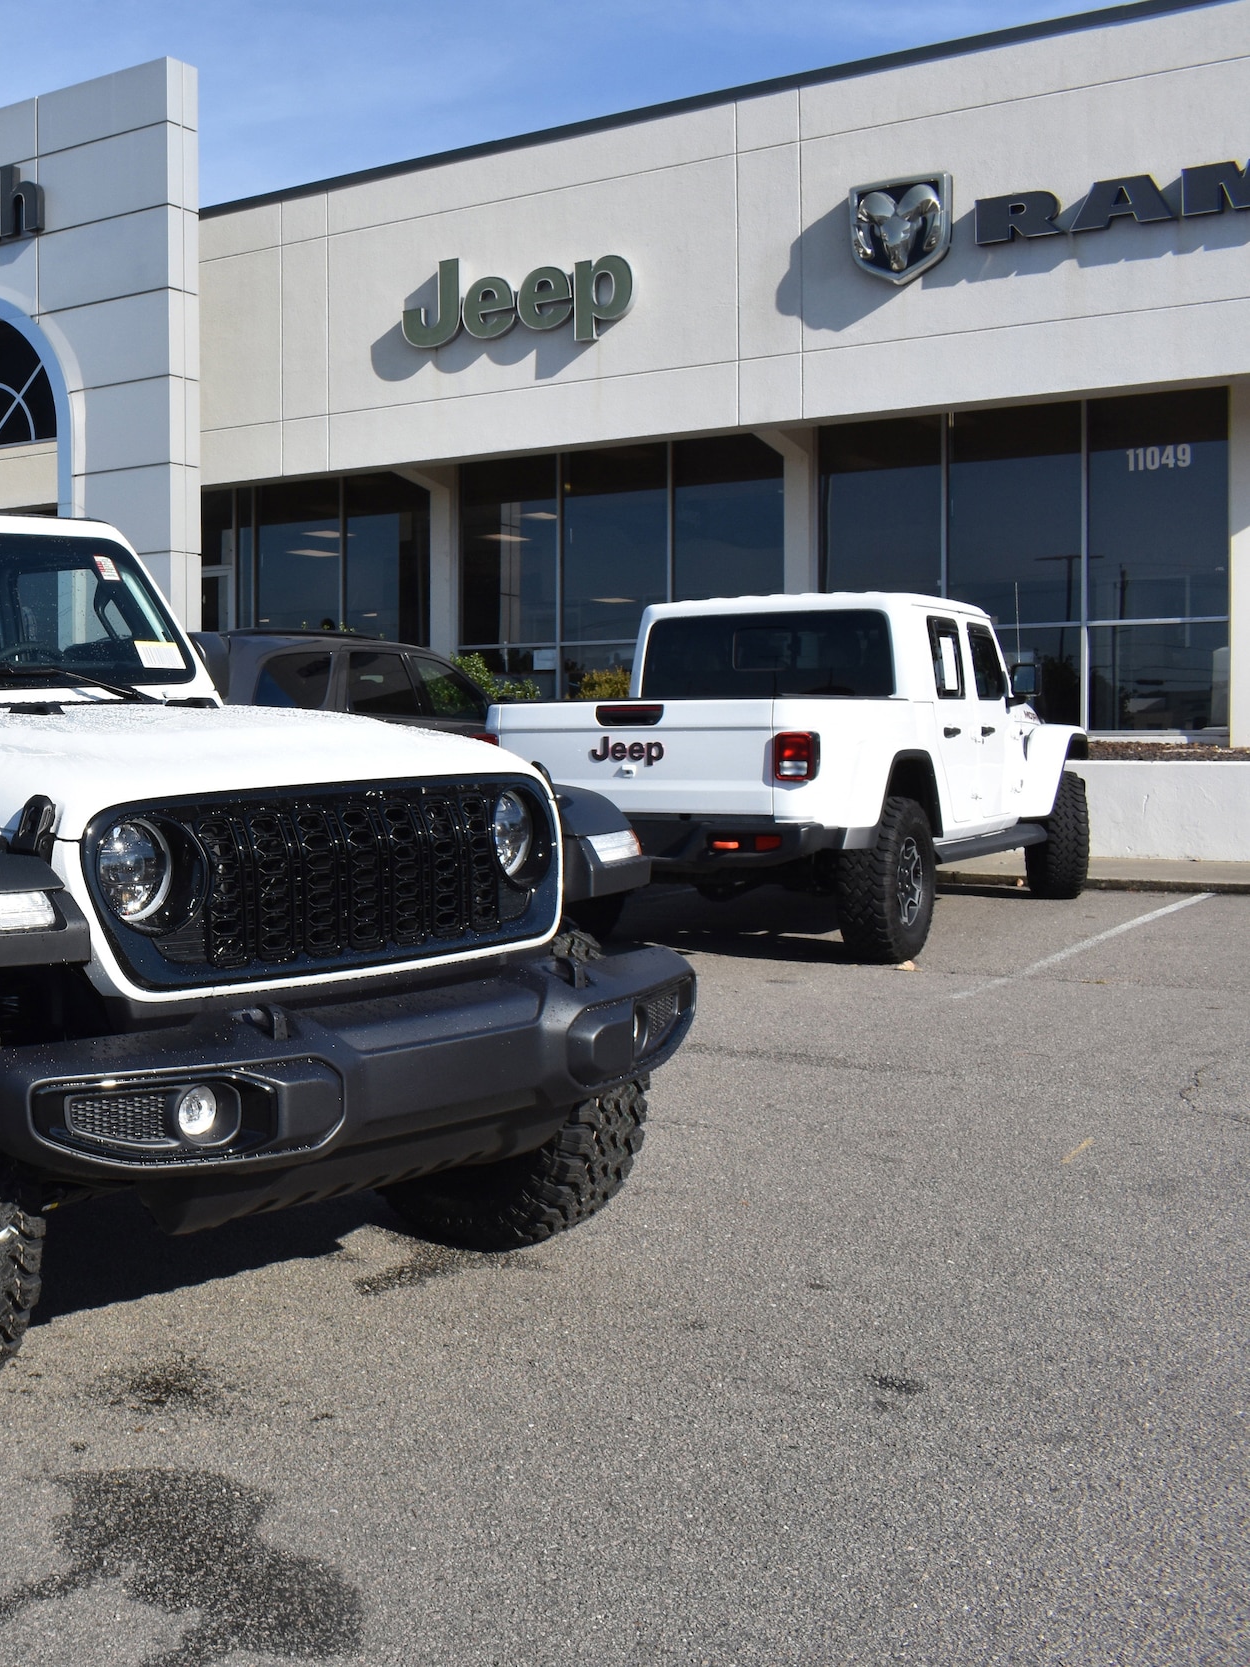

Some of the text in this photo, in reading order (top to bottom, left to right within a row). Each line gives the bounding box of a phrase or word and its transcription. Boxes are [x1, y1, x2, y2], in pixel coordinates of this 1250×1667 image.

[975, 159, 1250, 246] RAM
[401, 254, 637, 348] Jeep
[1126, 443, 1191, 471] 11049
[590, 736, 664, 766] Jeep
